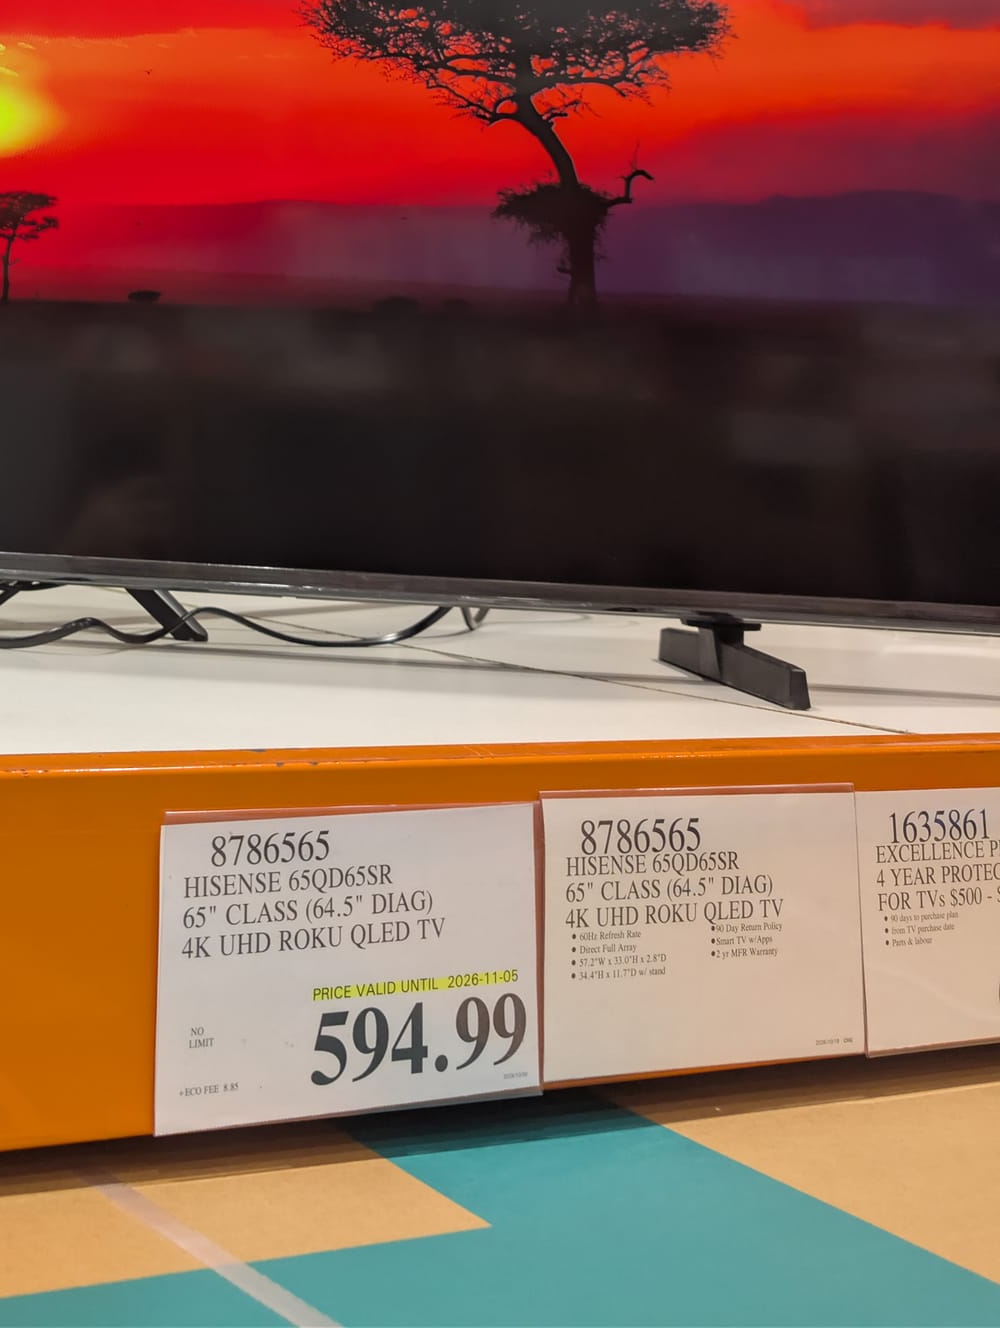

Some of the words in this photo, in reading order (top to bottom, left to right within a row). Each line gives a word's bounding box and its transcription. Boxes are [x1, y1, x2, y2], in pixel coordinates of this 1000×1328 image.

[581, 818, 701, 855] 8786565
[889, 808, 990, 844] 1635861
[211, 830, 330, 867] 8786565
[876, 840, 985, 864] EXCELLENCE
[989, 840, 1000, 858] P
[566, 854, 647, 876] HISENSE
[652, 851, 739, 876] 65QD65SR
[184, 871, 281, 898] HISENSE
[289, 864, 393, 893] 65QD65SR
[876, 869, 885, 887] 4
[890, 866, 936, 887] YEAR
[566, 882, 593, 903] 65"
[601, 879, 661, 901] CLASS
[667, 876, 714, 901] (64.5"
[721, 874, 773, 896] DIAG)
[878, 892, 912, 912] FOR
[916, 890, 946, 909] TVs
[950, 886, 982, 908] $500
[184, 906, 216, 929] 65"
[226, 900, 298, 925] CLASS
[306, 895, 362, 924] (64.5"
[371, 890, 433, 915] DIAG)
[565, 908, 589, 928] 4K
[597, 906, 638, 927] UHD
[645, 903, 698, 924] ROKU
[704, 900, 753, 924] QLED
[760, 898, 784, 918] TV
[900, 913, 912, 923] days
[921, 912, 945, 922] purchase
[946, 911, 959, 920] plan
[181, 936, 211, 959] 4K
[221, 931, 271, 956] UHD
[279, 926, 343, 952] ROKU
[351, 920, 410, 949] QLED
[417, 918, 445, 940] TV
[579, 932, 597, 941] 60Hz
[600, 930, 625, 940] Refresh
[626, 930, 641, 938] Rate
[726, 924, 738, 933] Day
[740, 923, 761, 932] Return
[763, 922, 782, 931] Policy
[906, 925, 917, 934] TV
[917, 924, 942, 934] purchase
[943, 923, 955, 931] date
[580, 945, 600, 954] Direct
[602, 944, 616, 953] Full
[618, 943, 637, 953] Array
[716, 936, 735, 945] Smart
[736, 935, 747, 944] TV
[892, 939, 906, 947] Parts
[915, 937, 932, 945] labour
[731, 948, 747, 957] MFR
[749, 948, 778, 957] Warranty
[648, 966, 666, 975] stand
[312, 985, 351, 1001] PRICE
[357, 981, 396, 997] VALID
[401, 977, 439, 993] UNTIL
[448, 969, 519, 988] 2026-11-05
[191, 1026, 204, 1036] NO
[311, 992, 527, 1086] 594.99
[189, 1038, 215, 1049] LIMIT
[204, 1084, 219, 1094] FEE
